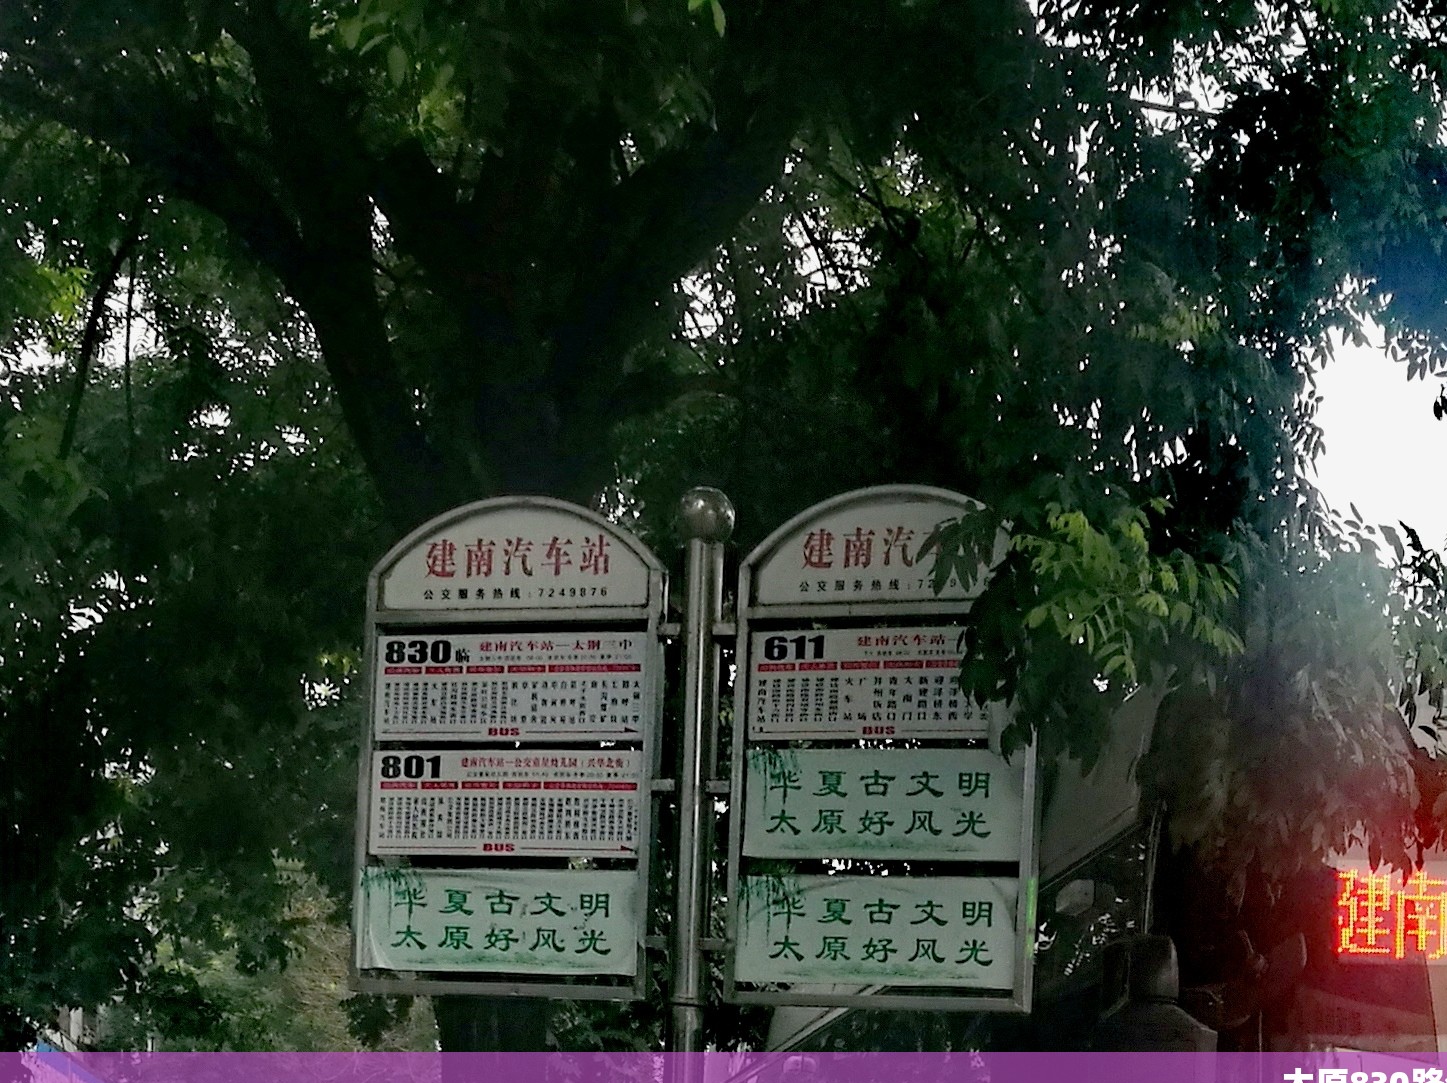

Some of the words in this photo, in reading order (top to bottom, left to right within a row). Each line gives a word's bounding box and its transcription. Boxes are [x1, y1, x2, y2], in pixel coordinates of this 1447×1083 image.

[424, 535, 611, 579] 建南汽车站
[802, 526, 985, 569] 建南汽
[385, 640, 451, 663] 830
[765, 635, 824, 660] 611
[488, 727, 520, 736] BUS
[863, 726, 895, 735] BUS
[381, 755, 441, 778] 801
[769, 770, 990, 804] 华夏古文明
[766, 809, 991, 838] 太原好风光
[483, 843, 515, 851] BUS
[394, 888, 611, 923] 华夏古文明
[772, 898, 993, 933] 华夏古文明
[391, 925, 612, 956] 太原好风光
[769, 936, 994, 966] 太原好风光
